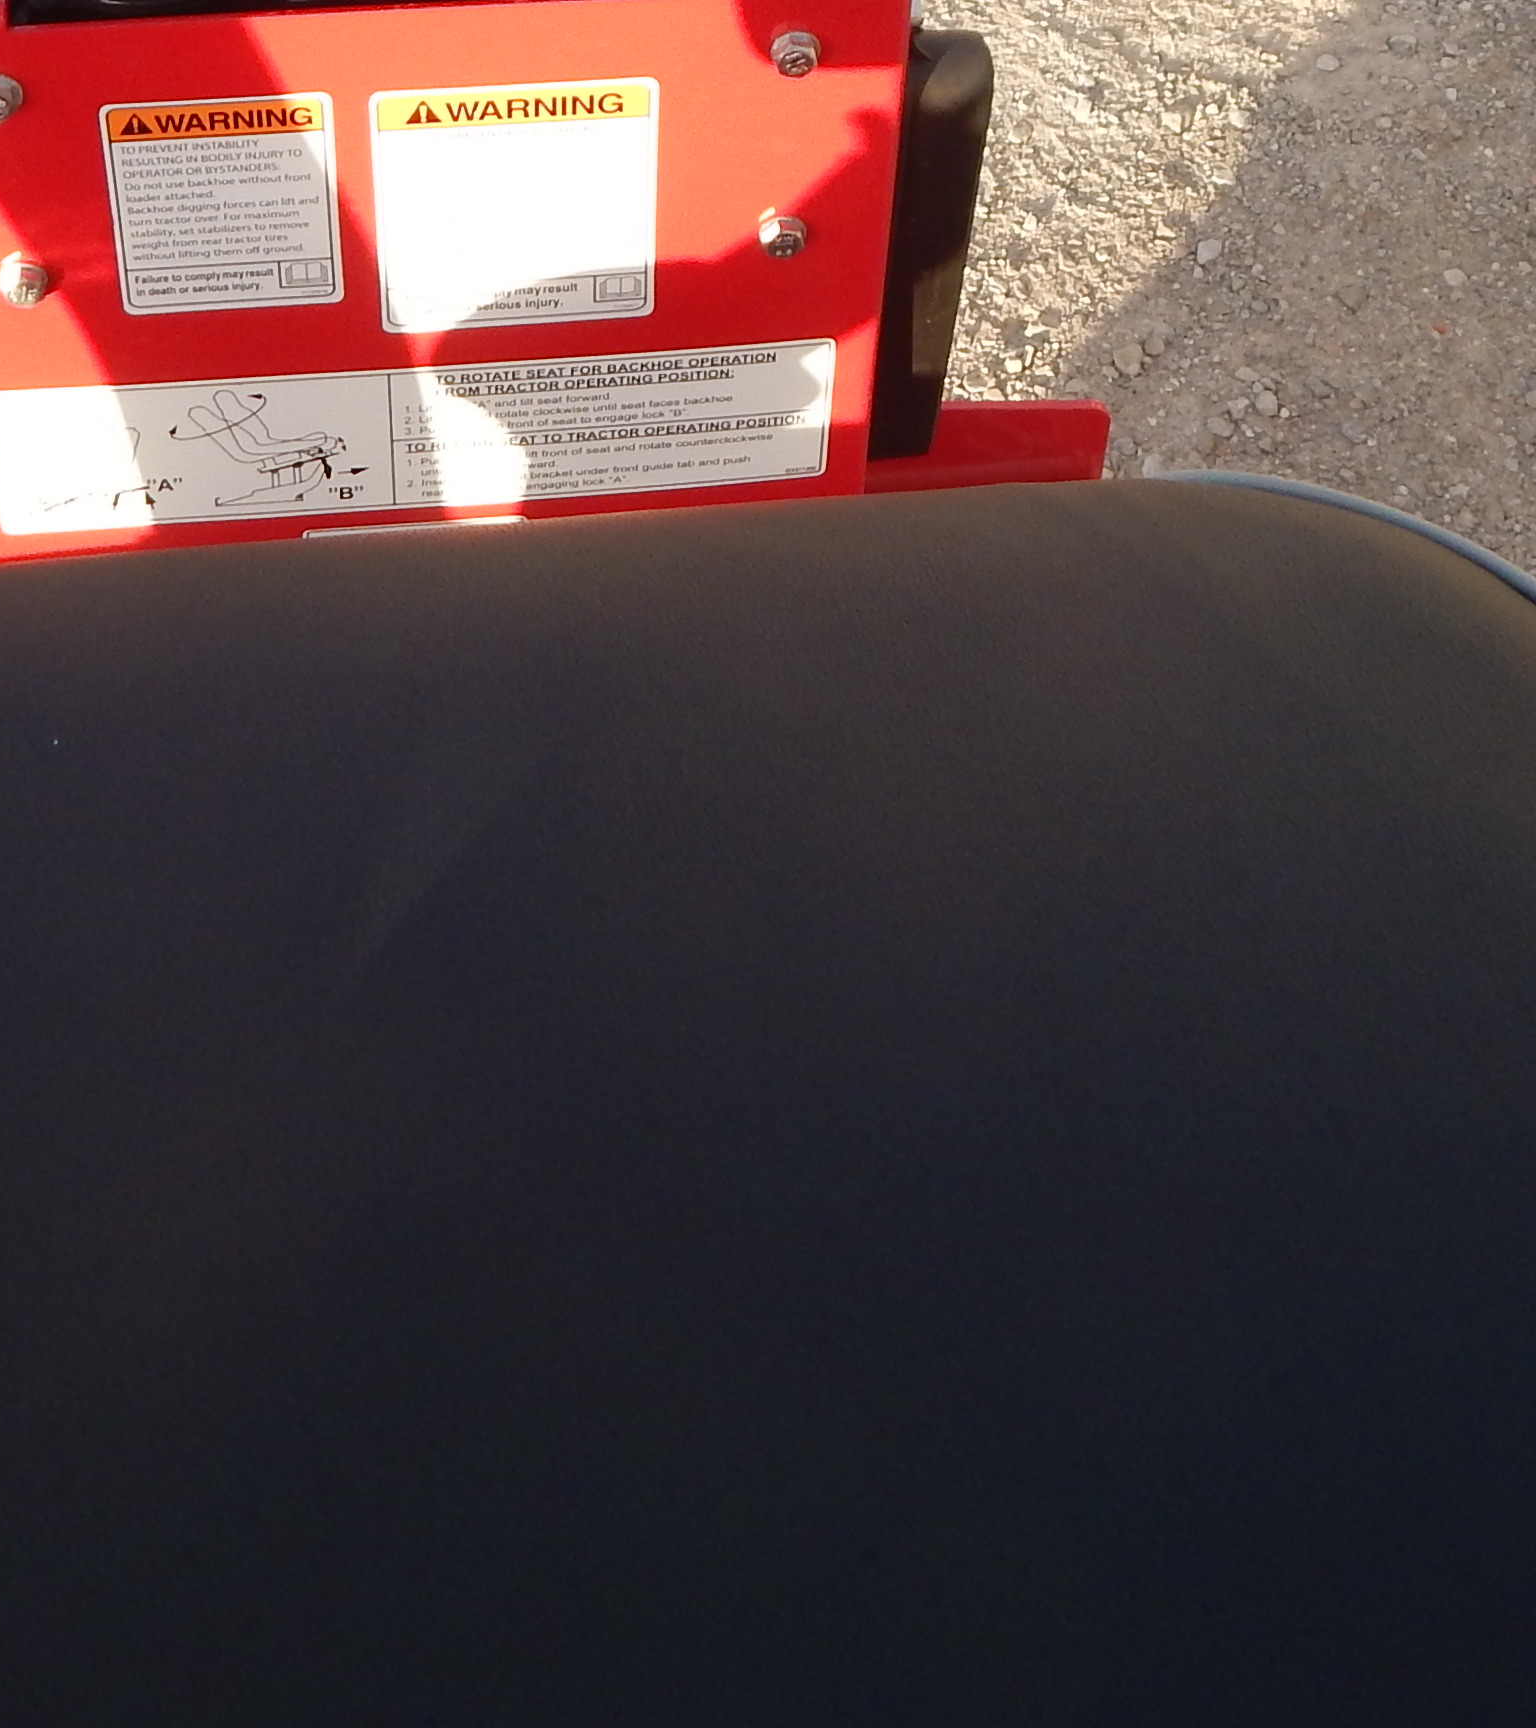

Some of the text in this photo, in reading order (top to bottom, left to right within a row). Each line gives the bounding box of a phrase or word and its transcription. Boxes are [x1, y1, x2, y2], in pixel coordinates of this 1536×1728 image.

[446, 92, 624, 122] WARNING
[155, 107, 314, 134] WARNING
[120, 139, 259, 155] TO PREVENT INSTABILITY
[121, 148, 303, 167] RESULTING IN BODILY INJURY TO
[122, 168, 184, 180] OPERATOR
[186, 166, 202, 176] OR
[124, 172, 312, 191] Do not use backhoe without front
[126, 194, 160, 203] loader
[127, 196, 320, 214] Backhoe digging forces can lift and
[128, 218, 152, 226] turn
[154, 216, 192, 225] tractor
[244, 210, 300, 220] maximum
[130, 228, 176, 238] stability,
[197, 224, 252, 234] stabilizers
[254, 223, 266, 231] to
[268, 221, 310, 230] remove
[132, 240, 170, 250] weight
[172, 239, 198, 248] from
[225, 235, 262, 244] tractor
[264, 234, 288, 242] tires
[132, 252, 176, 261] without
[178, 250, 210, 258] lifting
[213, 248, 242, 256] them
[245, 246, 260, 254] off
[134, 268, 274, 284] Failure to comply may result
[136, 282, 264, 296] in death or serious injury.
[514, 285, 541, 297] may
[542, 282, 578, 294] result
[476, 302, 521, 312] serious
[524, 298, 564, 310] injury.
[435, 352, 776, 385] TO ROTATE SEAT FOR BACKHOE OPERATION
[485, 381, 560, 394] TRACTOR
[564, 374, 653, 390] OPERATING
[658, 368, 734, 383] POSITION:
[494, 398, 517, 408] and
[537, 396, 562, 405] seat
[496, 409, 530, 419] rotate
[532, 406, 590, 417] clockwise
[592, 403, 617, 412] until
[620, 401, 646, 410] seat
[648, 399, 680, 408] faces
[507, 418, 534, 429] front
[536, 418, 549, 428] of
[552, 416, 578, 426] seat
[580, 416, 592, 424] to
[594, 412, 638, 422] engage
[642, 410, 665, 419] lock
[405, 443, 426, 454] TO
[544, 433, 562, 444] TO
[568, 428, 640, 442] TRACTOR
[644, 420, 731, 436] OPERATING
[542, 448, 568, 458] front
[571, 447, 583, 455] of
[586, 446, 611, 454] seat
[614, 443, 636, 452] and
[639, 441, 672, 450] rotate
[676, 434, 774, 448] counterclockwise
[530, 468, 573, 480] bracket
[576, 466, 609, 476] under
[612, 464, 639, 473] front
[642, 462, 674, 472] guide
[676, 460, 696, 468] tab
[698, 458, 720, 466] and
[723, 455, 751, 466] push
[146, 478, 183, 492] "A"
[526, 479, 580, 490] engaging
[582, 478, 605, 486] lock
[328, 485, 364, 500] "B"
